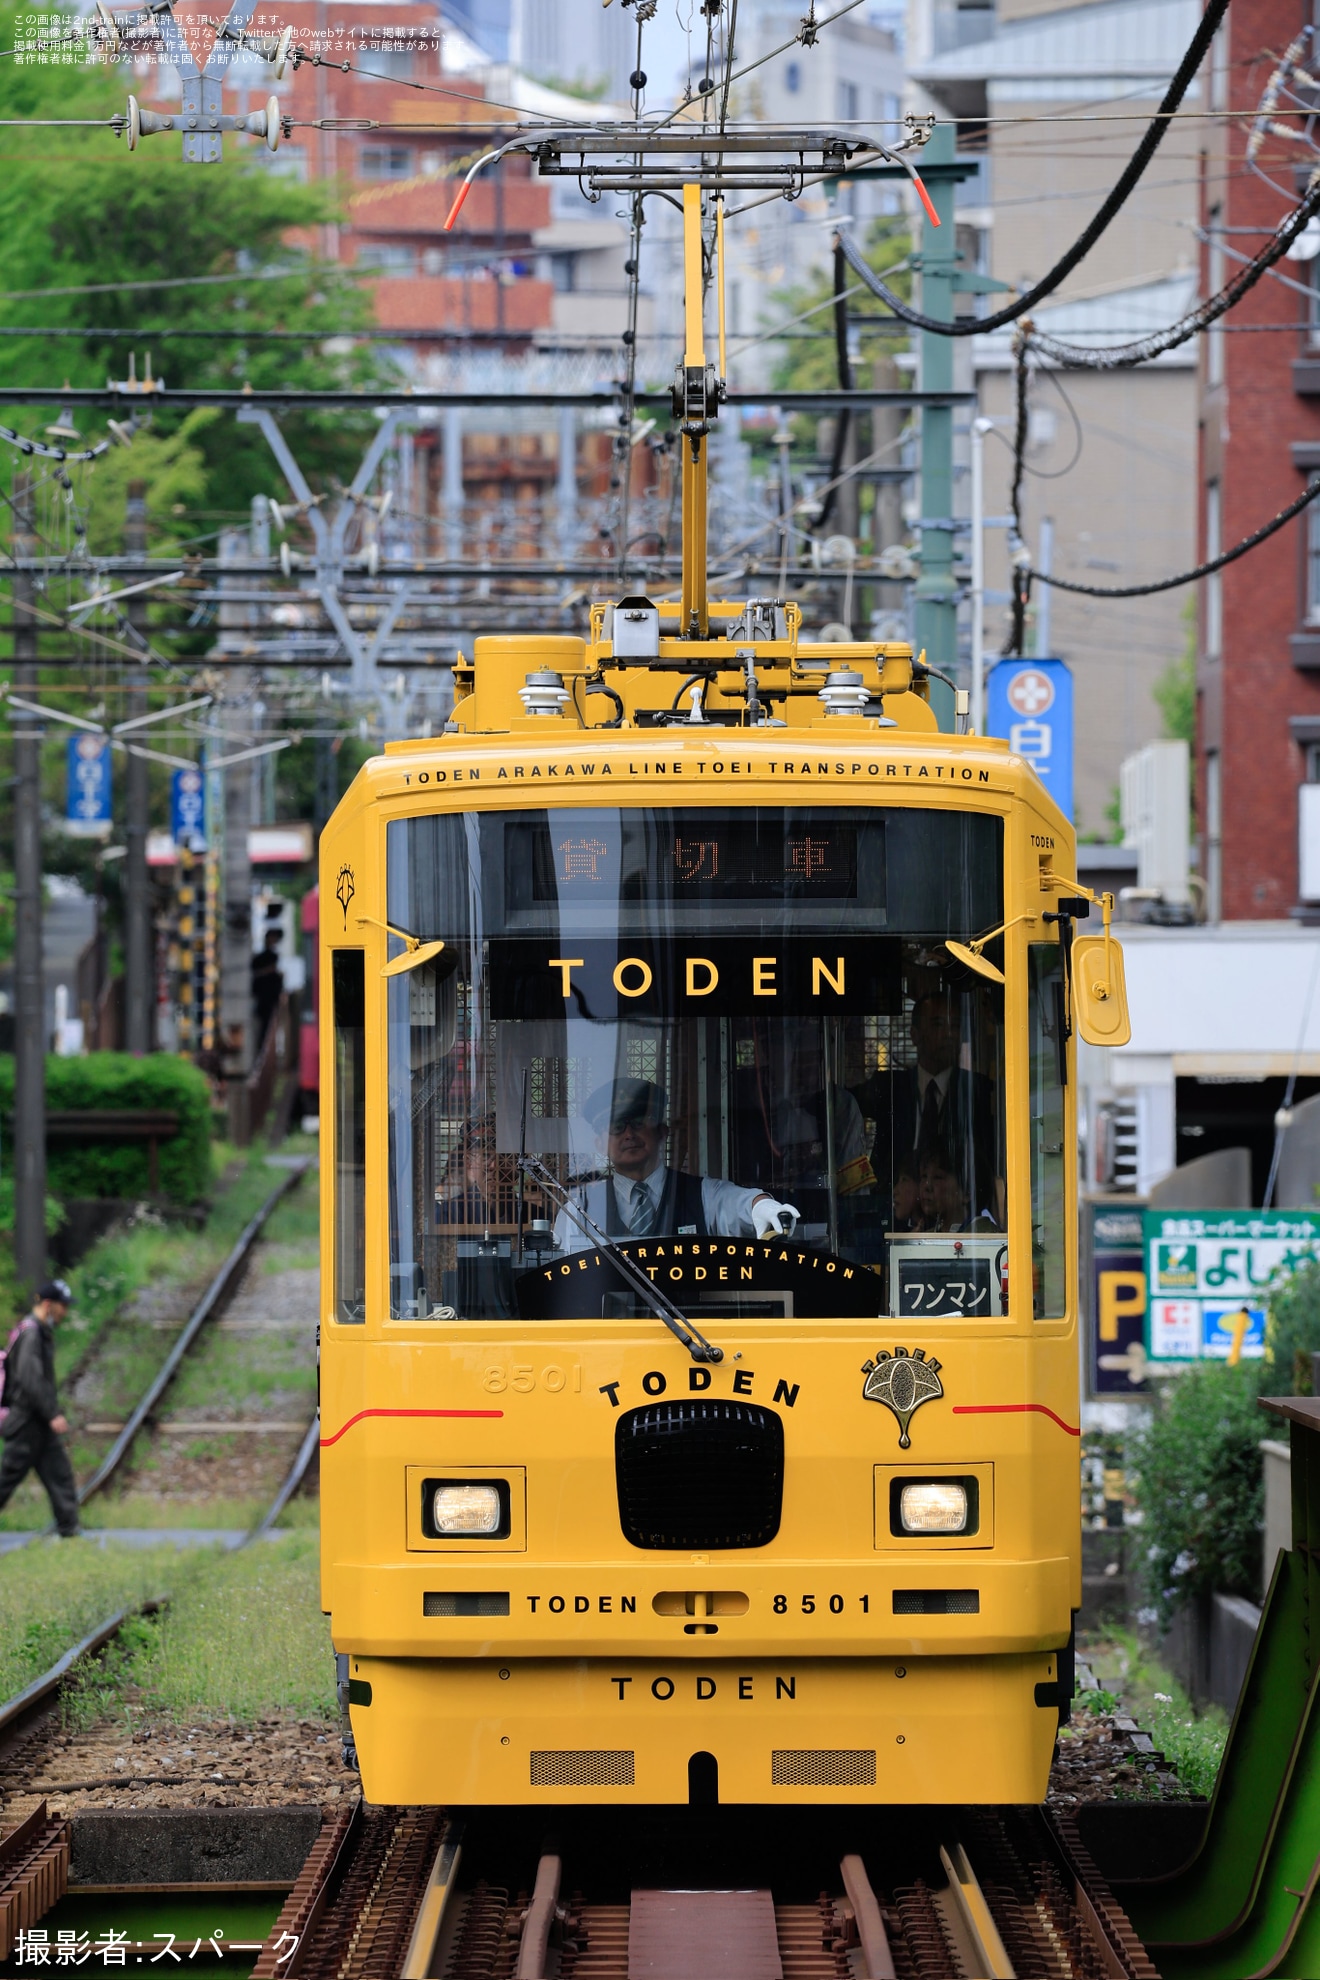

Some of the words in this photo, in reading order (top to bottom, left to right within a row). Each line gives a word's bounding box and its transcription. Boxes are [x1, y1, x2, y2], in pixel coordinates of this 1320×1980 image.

[404, 768, 480, 785] TODEN
[498, 763, 613, 778] ARAKAWA
[629, 762, 682, 775] LINE
[698, 762, 751, 774] TOEI
[769, 762, 990, 783] TRANSPORTATION
[1030, 834, 1055, 849] TODEN
[548, 957, 845, 997] TODEN
[544, 1256, 601, 1281] TOEI
[646, 1266, 754, 1280] TODEN
[904, 1283, 987, 1309] ワンマン
[1099, 1271, 1146, 1342] P
[861, 1346, 943, 1375] TODEN
[481, 1365, 582, 1394] 8501
[599, 1367, 801, 1408] TODEN
[527, 1596, 638, 1614] TODEN
[773, 1594, 870, 1614] 8501
[611, 1677, 797, 1700] TODEN
